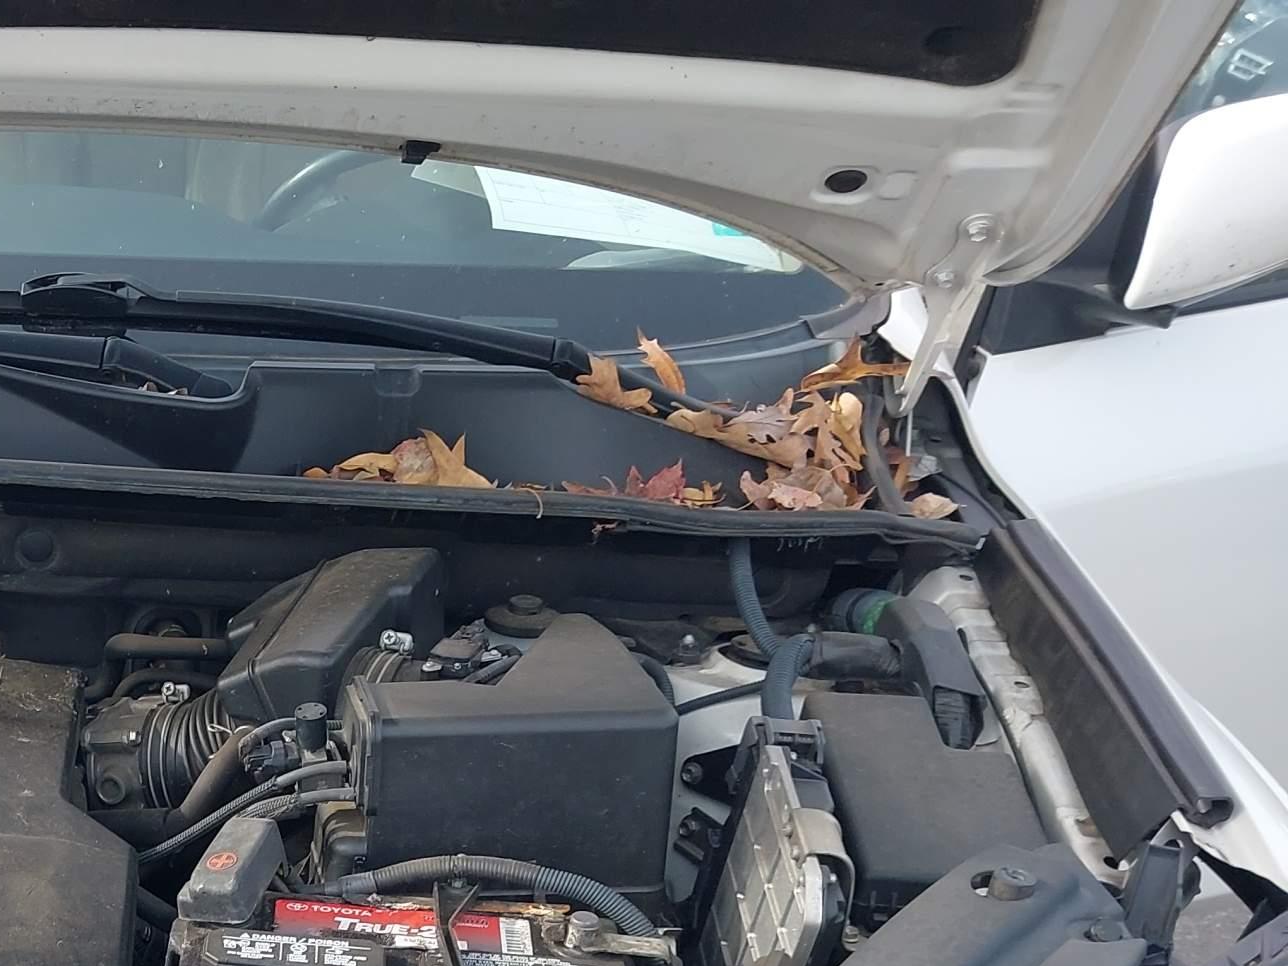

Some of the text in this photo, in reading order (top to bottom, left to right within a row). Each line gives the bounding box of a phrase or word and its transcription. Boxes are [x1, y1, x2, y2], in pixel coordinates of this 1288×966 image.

[311, 903, 372, 917] TOYOTA
[251, 933, 297, 944] DANGER
[308, 937, 350, 947] POISON
